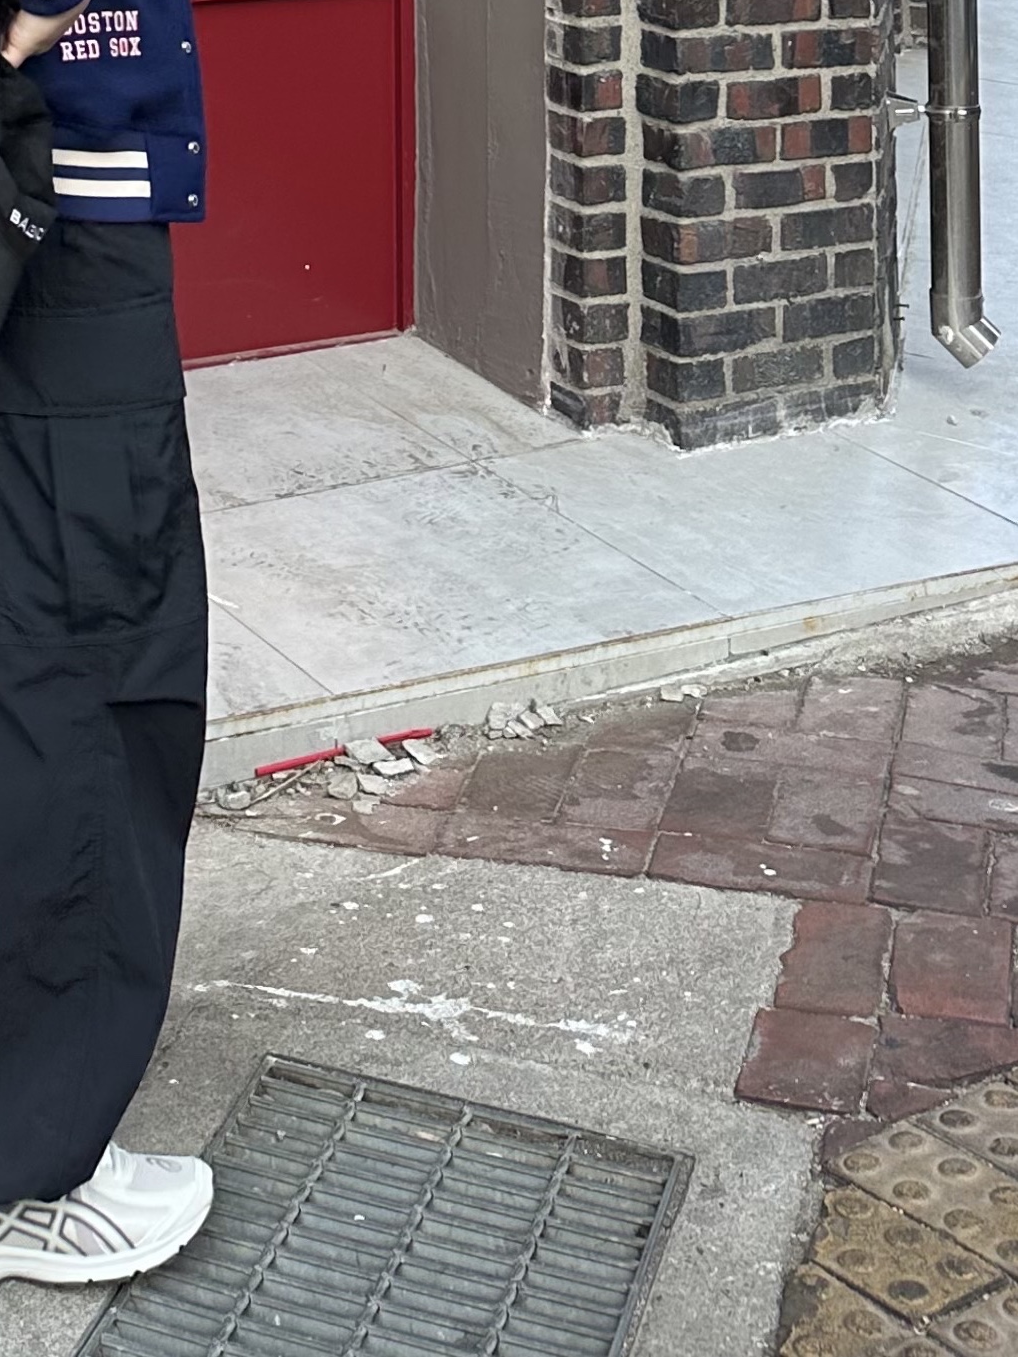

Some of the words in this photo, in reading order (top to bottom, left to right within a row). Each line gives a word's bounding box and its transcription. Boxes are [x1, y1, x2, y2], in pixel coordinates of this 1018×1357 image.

[63, 9, 139, 36] OSTON
[59, 39, 101, 62] RED
[109, 36, 142, 57] SOX
